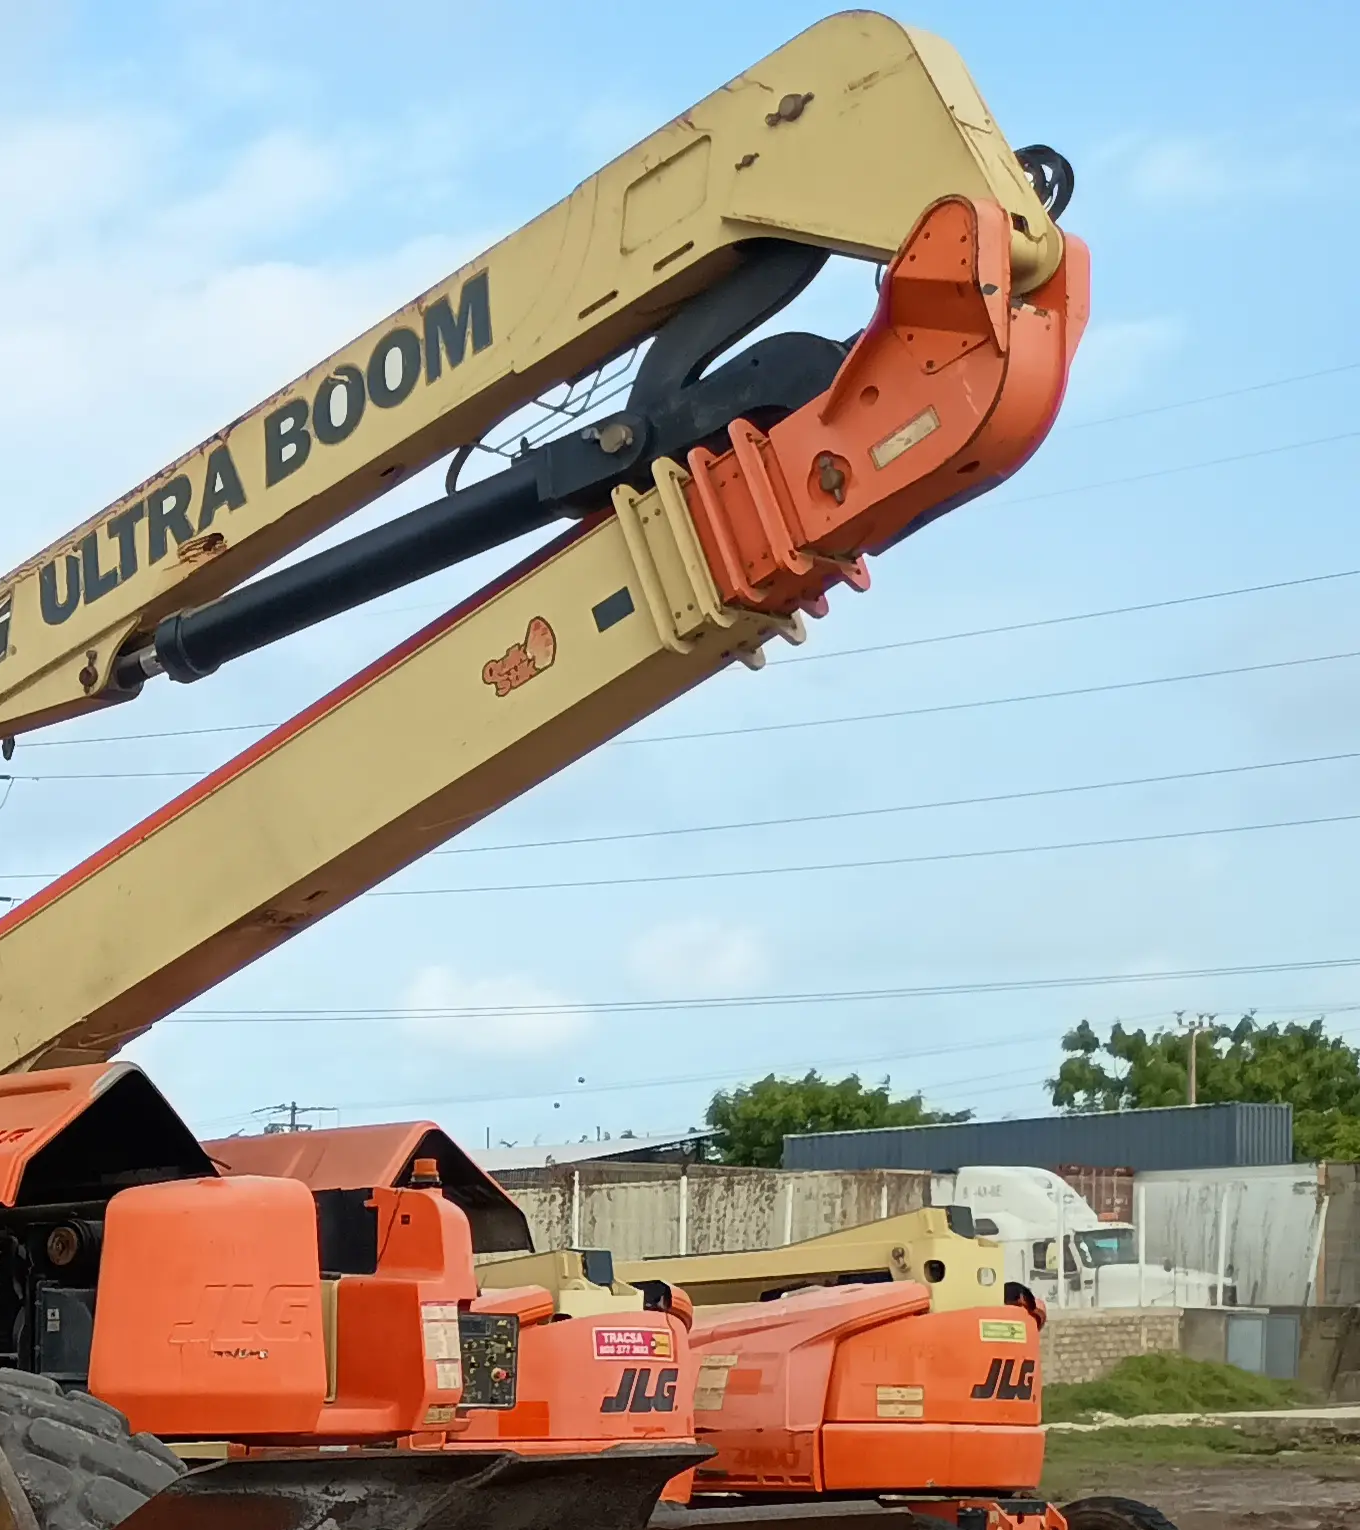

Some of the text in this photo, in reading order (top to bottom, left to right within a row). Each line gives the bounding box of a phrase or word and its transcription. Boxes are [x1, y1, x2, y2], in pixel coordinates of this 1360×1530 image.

[37, 443, 248, 626] ULTRA
[264, 266, 493, 489] BOOM
[168, 1284, 314, 1344] JLG
[601, 1332, 644, 1344] TRACSA
[600, 1368, 679, 1413] JLG
[970, 1358, 1036, 1402] JLG
